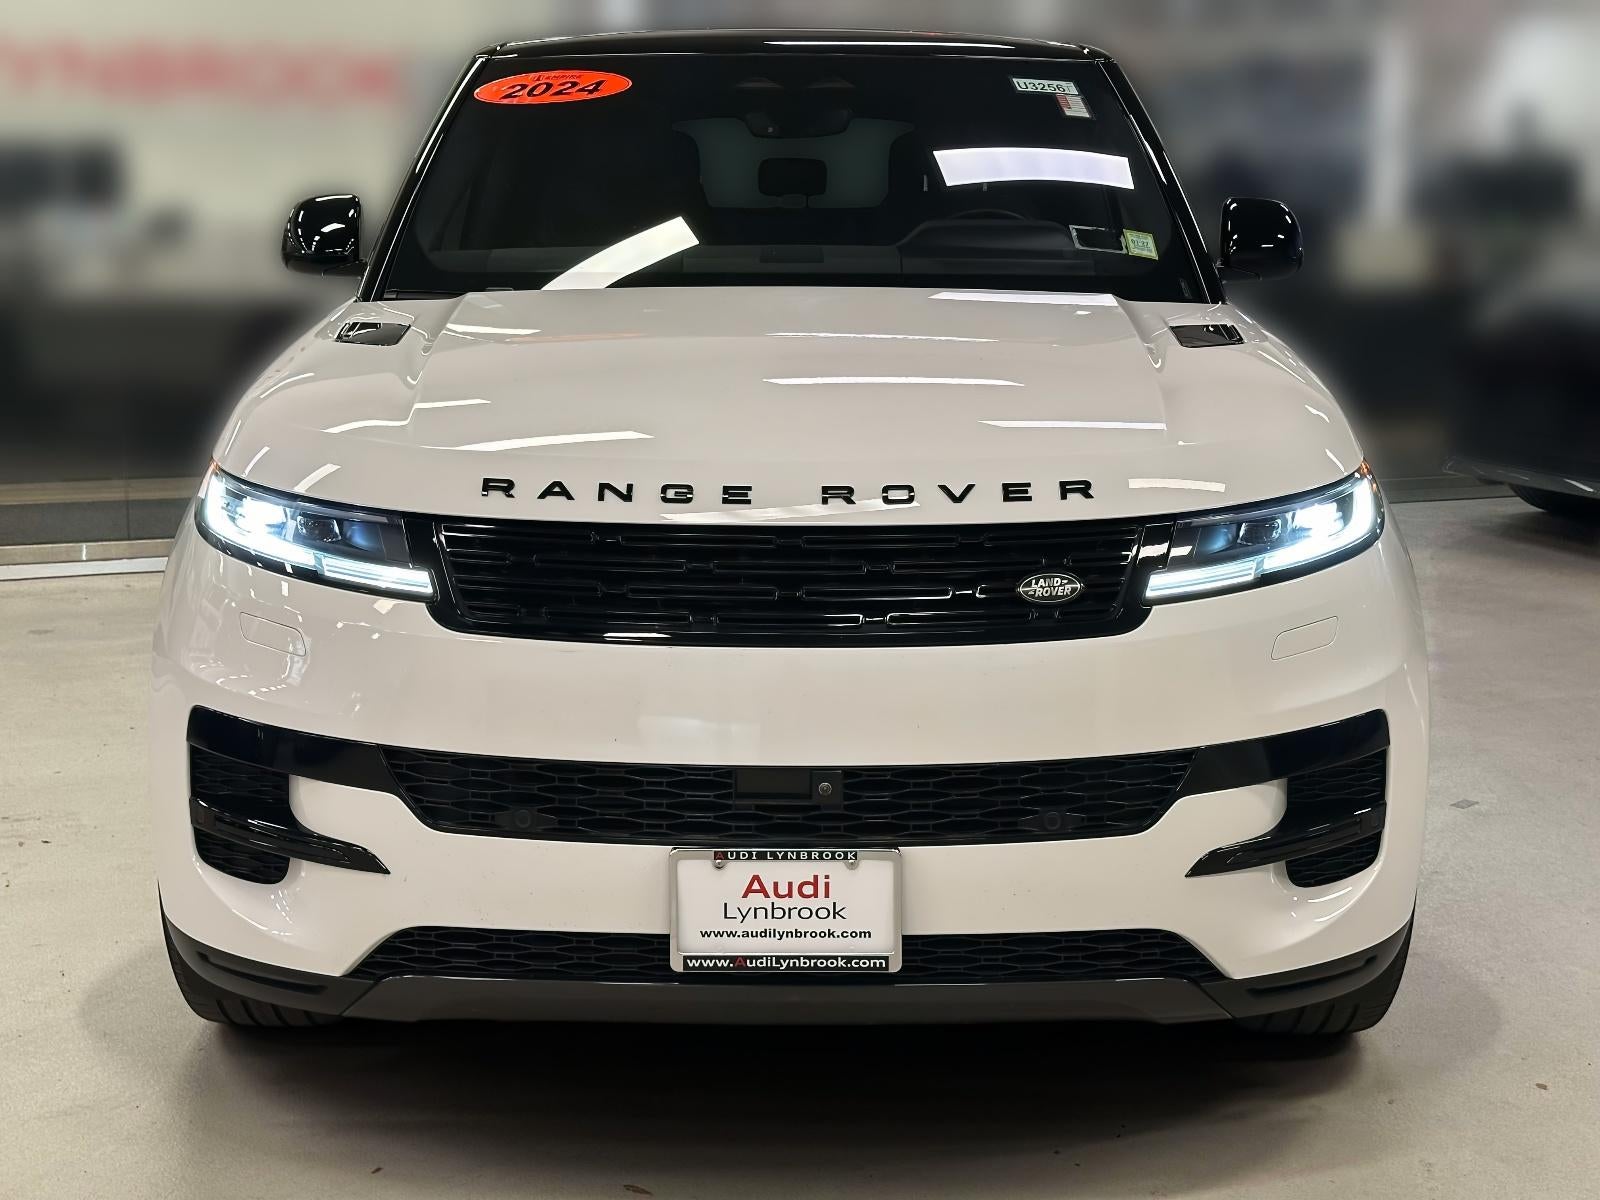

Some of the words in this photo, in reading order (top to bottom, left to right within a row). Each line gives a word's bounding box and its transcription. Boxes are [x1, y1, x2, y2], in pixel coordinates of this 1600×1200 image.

[499, 79, 607, 101] 2024
[481, 477, 753, 506] RANGE
[821, 478, 1096, 506] ROVER
[1031, 578, 1062, 588] LAND
[1034, 586, 1072, 597] ROVER
[715, 851, 758, 860] AUDI
[767, 851, 857, 860] LYNBROOK
[741, 874, 831, 899] Audi
[723, 902, 847, 923] Lynbrook
[700, 928, 872, 940] www.audilynbrook.com
[686, 956, 887, 970] www.AudiLynbrook.com
